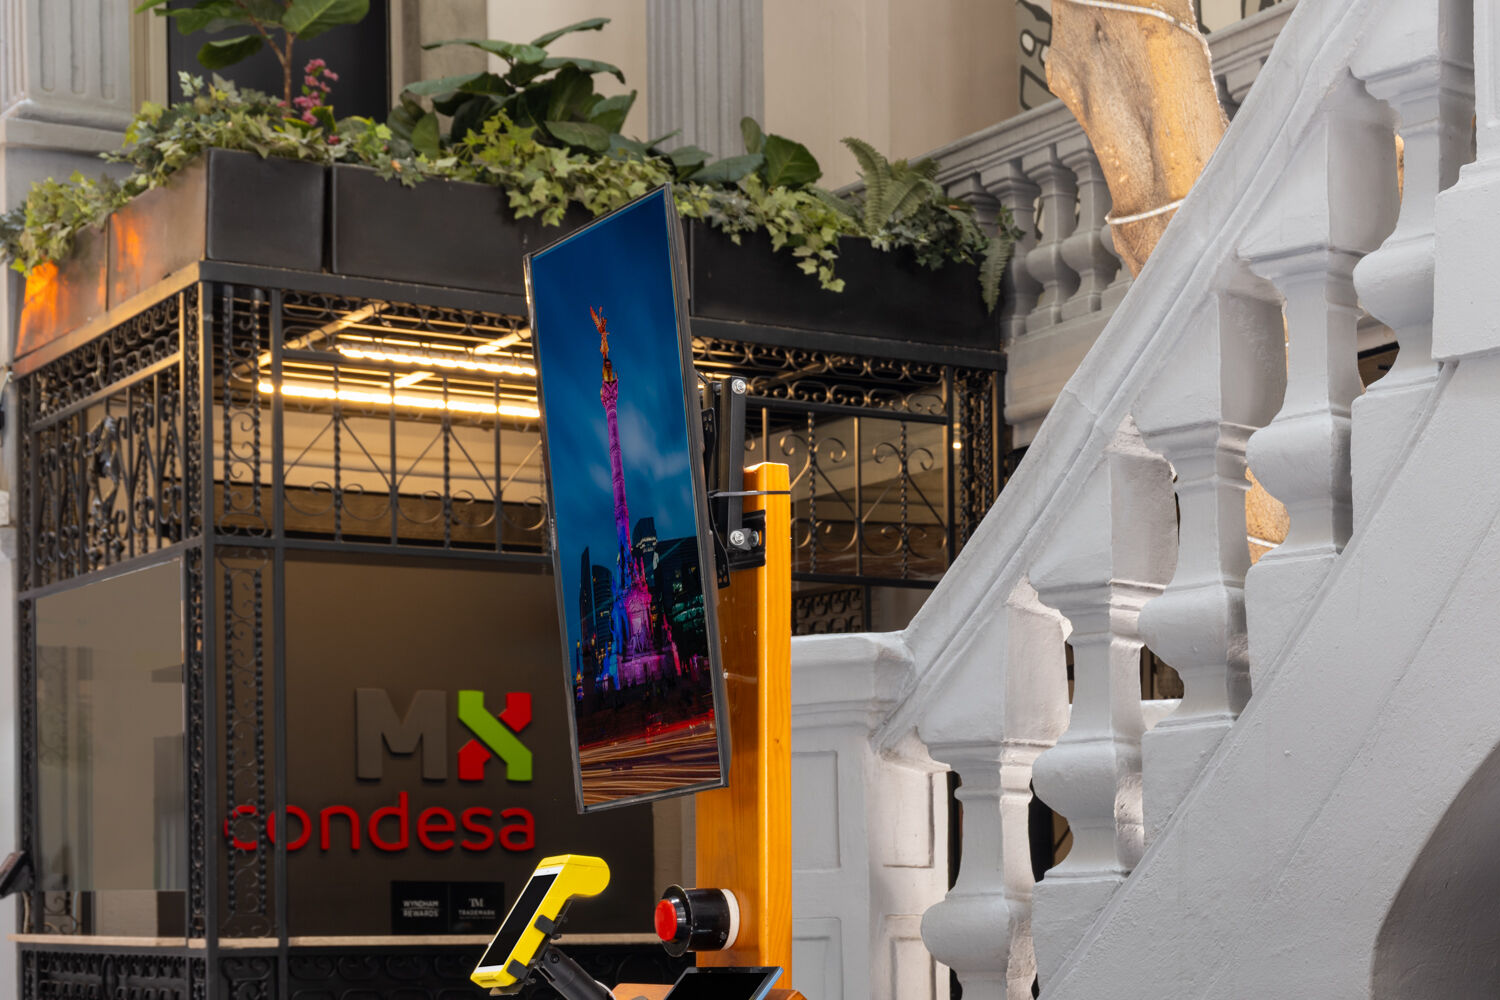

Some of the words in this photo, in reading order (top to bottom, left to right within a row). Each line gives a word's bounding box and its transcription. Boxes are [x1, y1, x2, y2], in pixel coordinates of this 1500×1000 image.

[356, 688, 533, 782] MX
[224, 791, 536, 851] condesa
[403, 900, 439, 908] WYNDHAM
[403, 910, 439, 918] REWARDS
